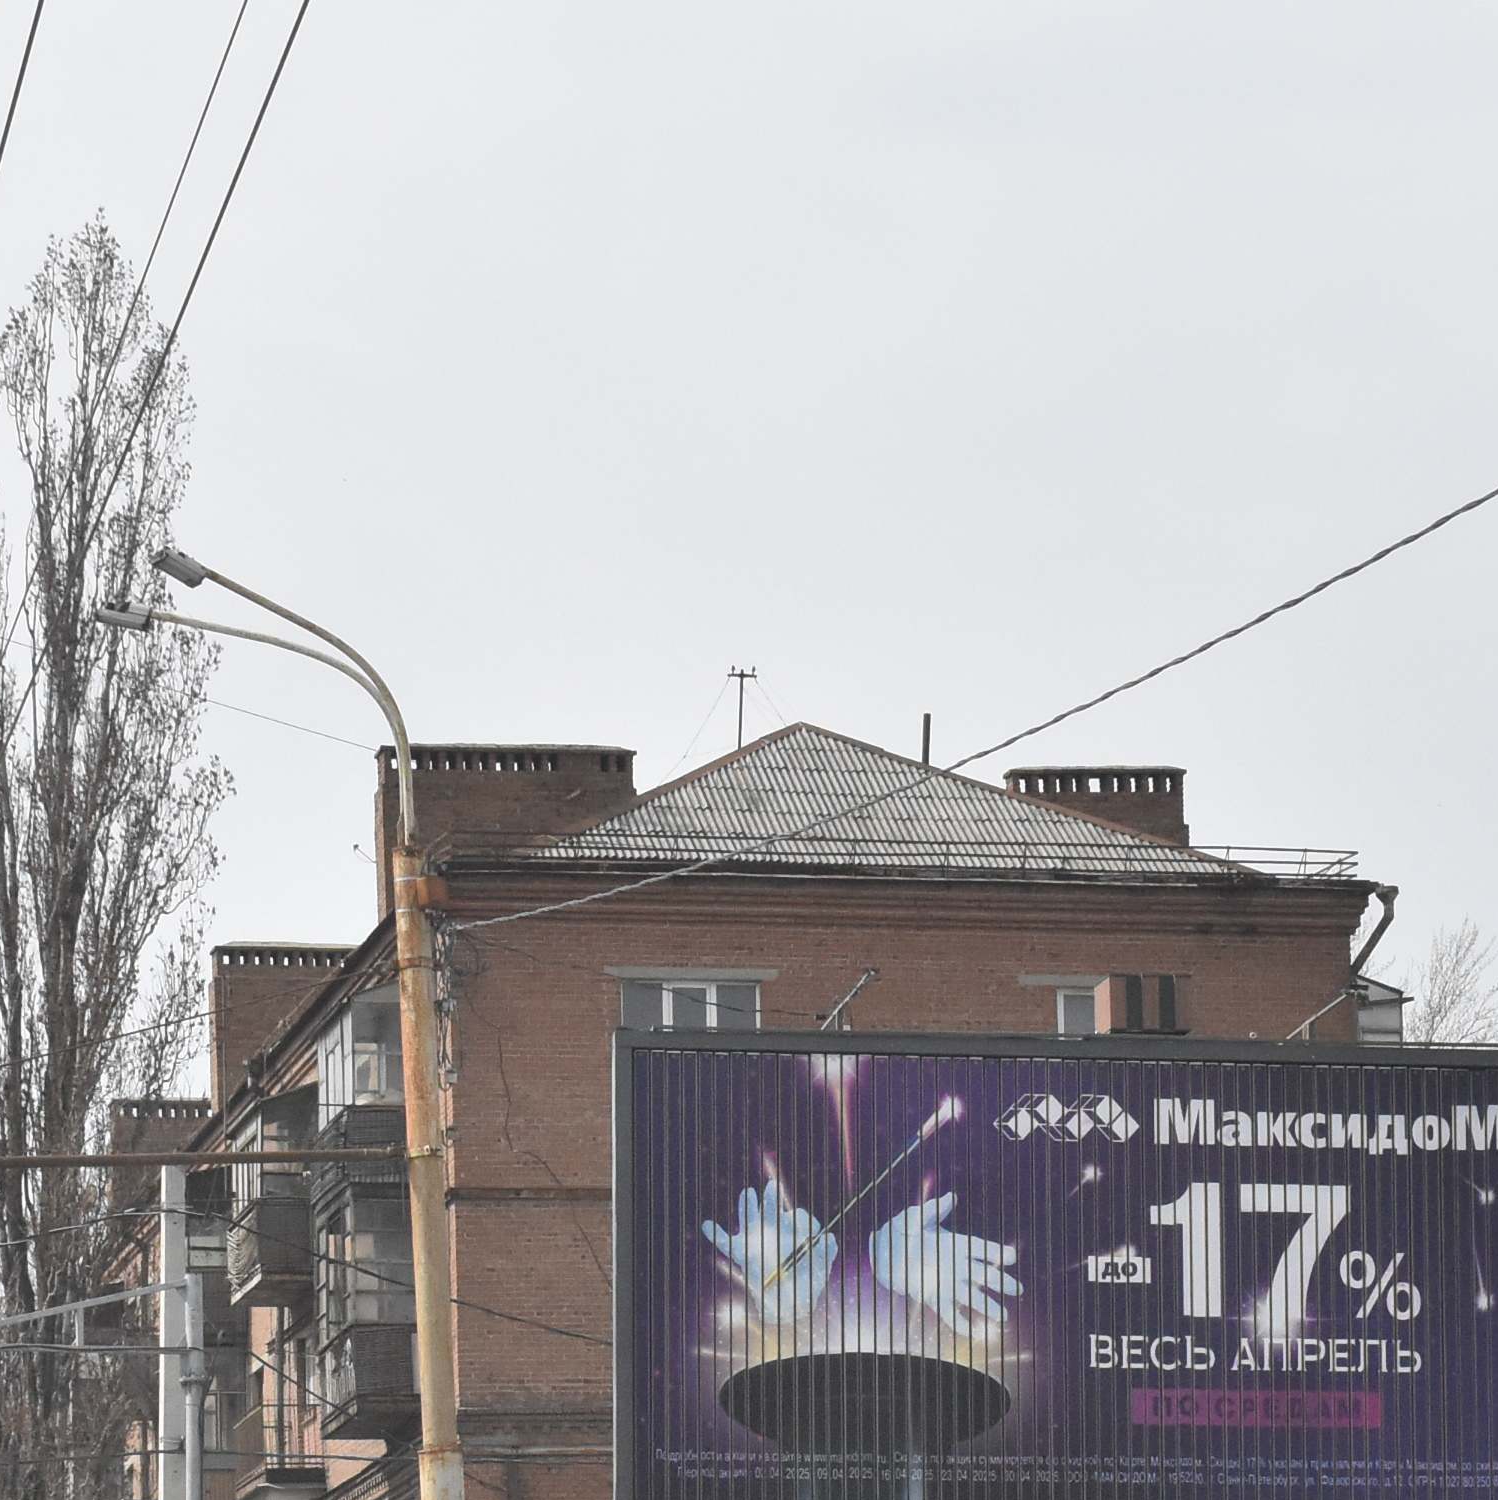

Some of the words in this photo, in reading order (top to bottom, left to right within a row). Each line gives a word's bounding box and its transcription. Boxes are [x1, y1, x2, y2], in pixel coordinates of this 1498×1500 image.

[1101, 1257, 1139, 1280] до
[1089, 1334, 1216, 1371] ВЕСЬ
[1230, 1337, 1422, 1373] АПРЕЛЬ
